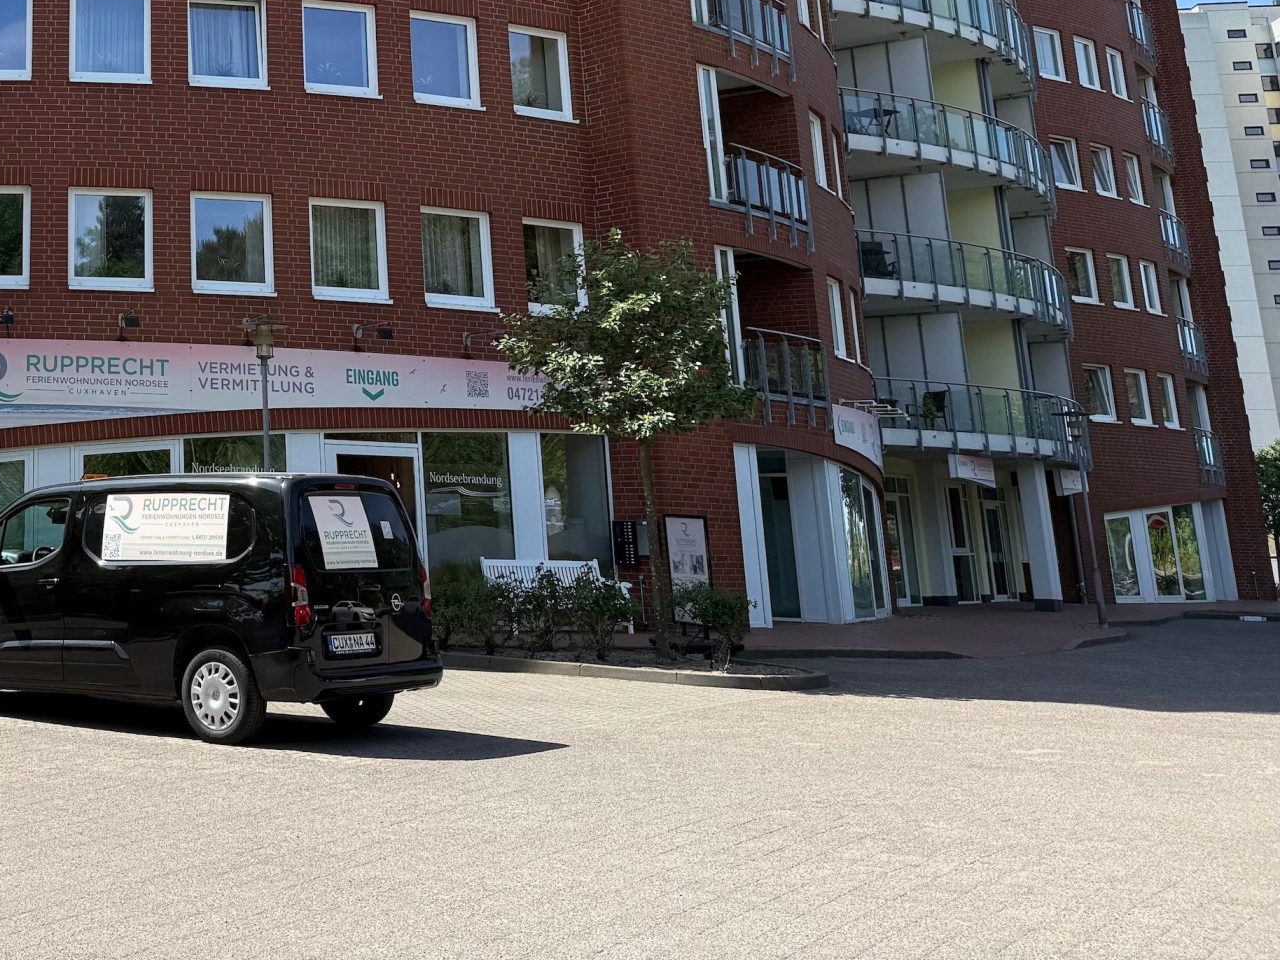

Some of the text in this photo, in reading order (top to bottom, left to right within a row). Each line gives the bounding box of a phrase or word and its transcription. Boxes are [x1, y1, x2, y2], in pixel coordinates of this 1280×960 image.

[26, 354, 170, 377] RUPPRECHT
[198, 361, 315, 378] VERMIEUNG &
[26, 375, 169, 388] FERIENWOHNUNGEN NORDSEE
[198, 377, 315, 394] VERMITLUNG
[346, 368, 400, 387] EINGANG
[68, 387, 127, 396] CUXHAVEN
[507, 386, 539, 402] 04721
[429, 471, 503, 488] Nordseebrandung
[142, 497, 227, 512] RUPPRECHT
[323, 530, 368, 540] RUPPRECHT
[332, 636, 350, 650] CUX
[365, 634, 375, 648] 44
